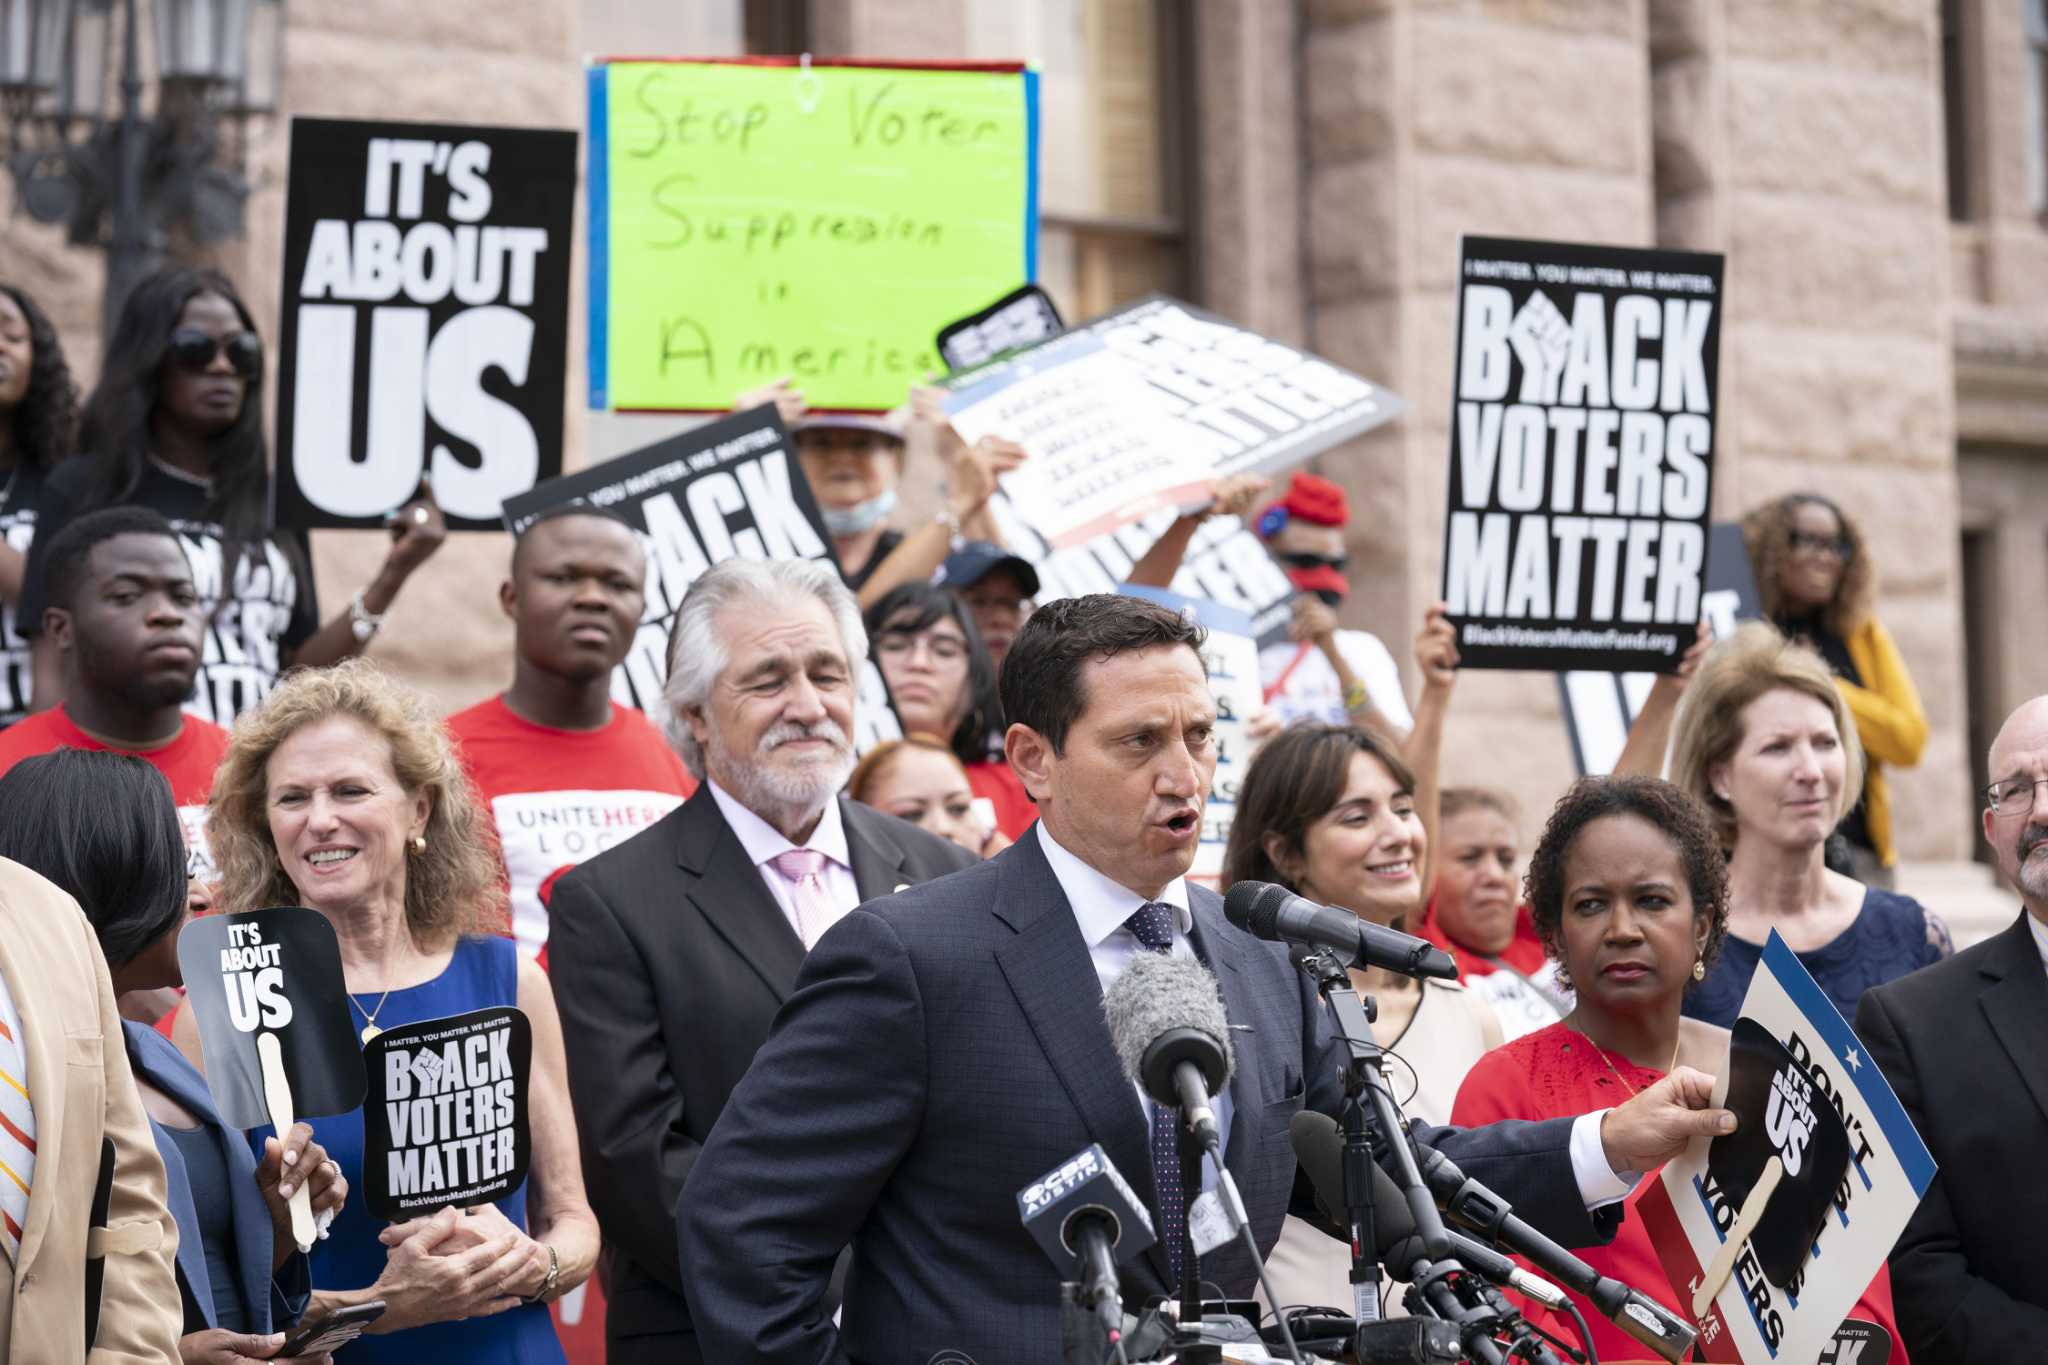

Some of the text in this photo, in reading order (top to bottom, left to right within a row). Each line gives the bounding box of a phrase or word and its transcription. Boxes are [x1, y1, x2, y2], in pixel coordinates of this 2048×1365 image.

[627, 71, 998, 159] Stop Voter
[365, 137, 491, 221] IT'S
[300, 220, 548, 305] ABOUT
[1464, 258, 1472, 277] I
[1535, 263, 1570, 283] YOU
[1630, 270, 1655, 289] WE
[658, 315, 933, 384] America
[1459, 284, 1712, 413] BACK
[293, 305, 539, 521] US
[588, 481, 628, 508] YOU
[688, 449, 716, 472] WE
[1458, 401, 1711, 519] VOTERS
[1447, 511, 1705, 624] MATTER
[1463, 624, 1678, 655] BlackVotersMatterFund.org
[541, 831, 613, 854] LOC
[220, 943, 281, 972] ABOUT
[227, 922, 262, 947] IT'S
[222, 967, 293, 1032] US
[389, 1036, 421, 1048] MATTER.
[422, 1033, 439, 1042] YOU
[440, 1027, 470, 1039] MATTER.
[471, 1023, 483, 1032] WE
[484, 1016, 512, 1029] MATTER.
[385, 1027, 513, 1101] BACK
[1786, 1063, 1813, 1103] IT'S
[1788, 1030, 1875, 1164] DON'T
[386, 1079, 514, 1148] VOTERS
[1765, 1083, 1810, 1177] US
[1772, 1069, 1818, 1133] ABOUT
[387, 1126, 514, 1197] MATTER
[400, 1179, 508, 1208] BlackVotersMatterFund.org
[1026, 1162, 1098, 1215] AUSTIN
[1702, 1168, 1785, 1350] VOERS
[1697, 1318, 1712, 1345] EXAS
[1837, 1328, 1871, 1337] MATTER.
